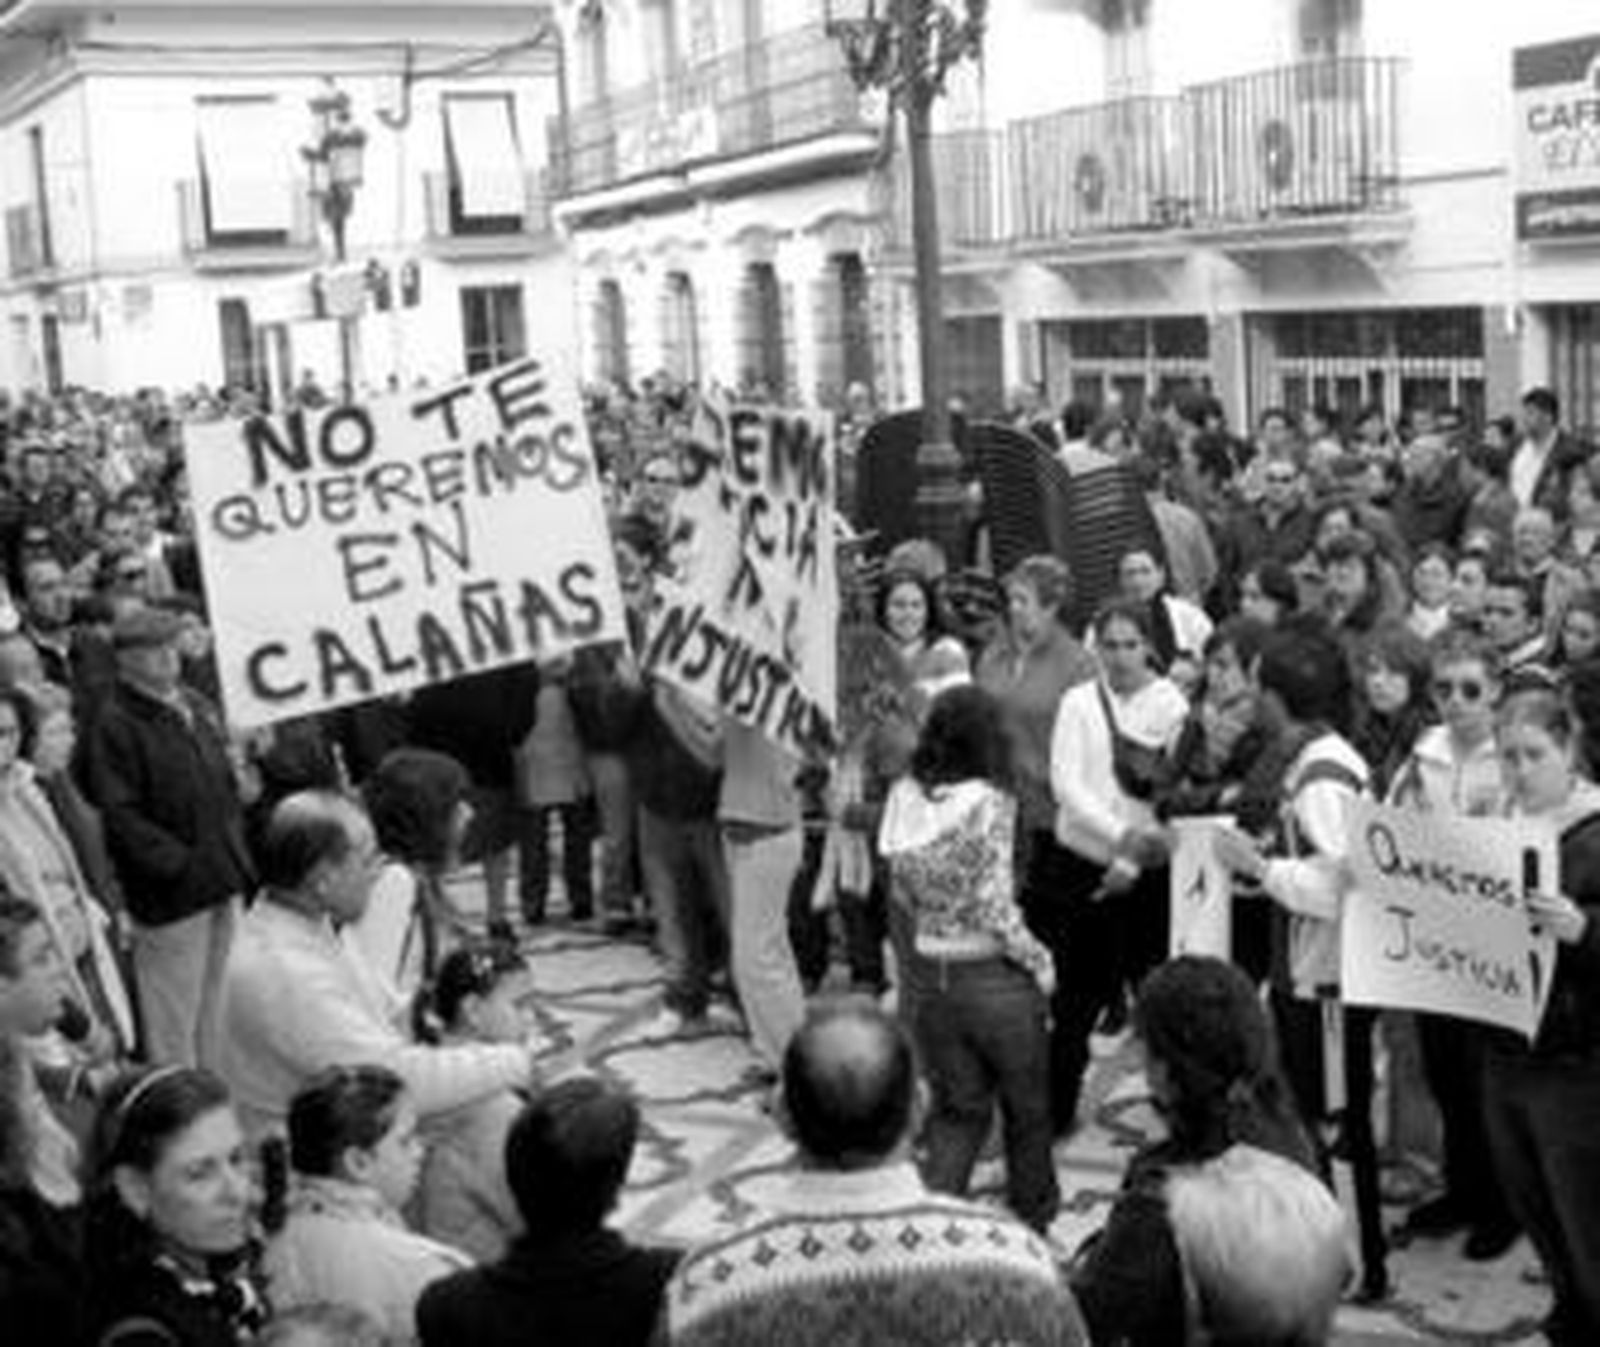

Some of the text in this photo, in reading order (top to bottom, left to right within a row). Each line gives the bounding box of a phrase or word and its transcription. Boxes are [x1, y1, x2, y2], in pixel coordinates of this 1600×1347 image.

[212, 422, 590, 541] QUEREMOS
[243, 358, 552, 489] NO TE
[335, 500, 472, 604] EN
[245, 562, 604, 702] CALAÑAS
